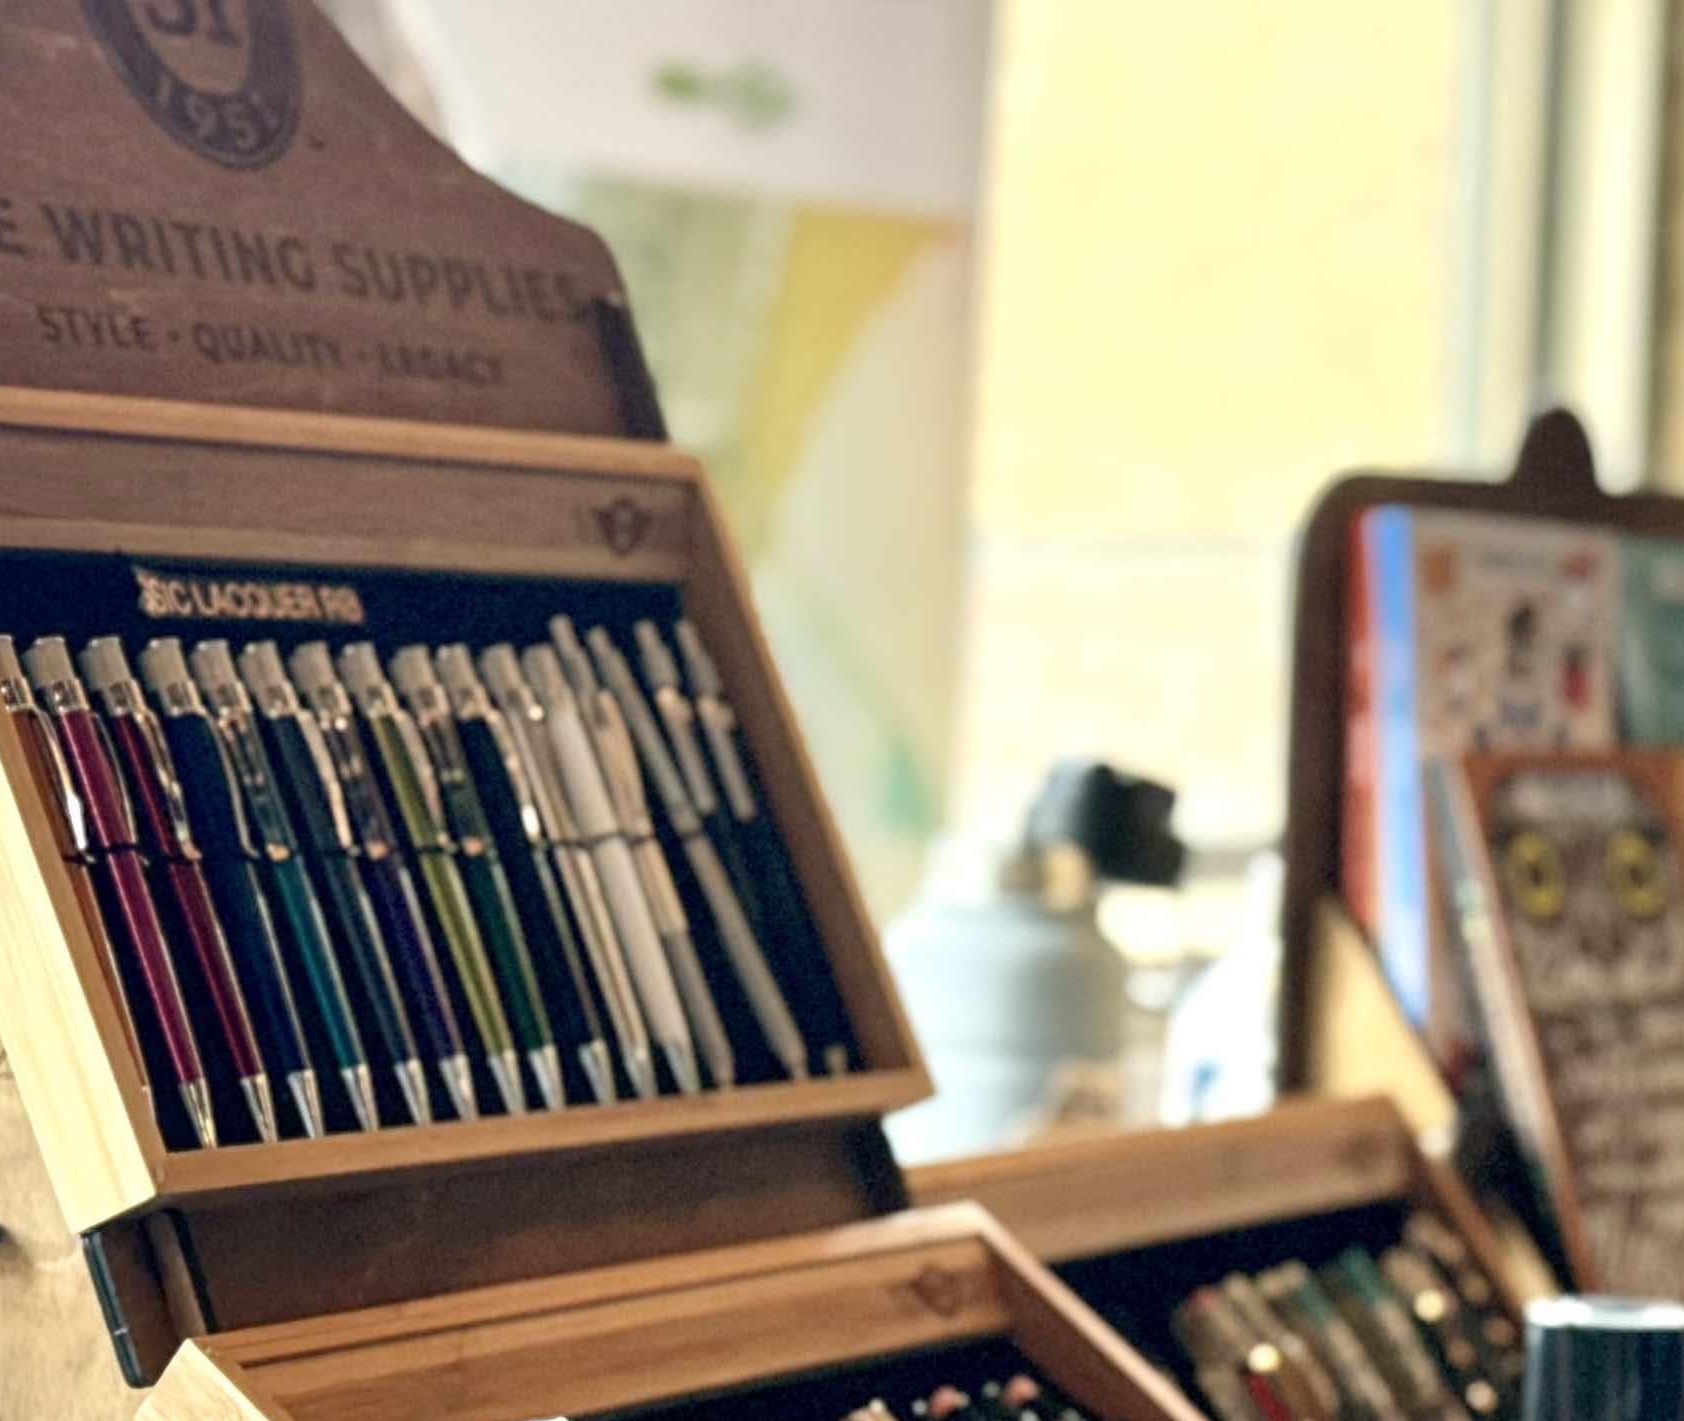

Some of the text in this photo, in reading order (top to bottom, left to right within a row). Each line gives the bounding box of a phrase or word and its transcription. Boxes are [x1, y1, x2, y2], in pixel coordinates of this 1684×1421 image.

[42, 203, 315, 292] WRITING
[332, 240, 583, 326] SUPPLIES
[36, 304, 152, 351] STYLE
[192, 320, 344, 370] QUALITY
